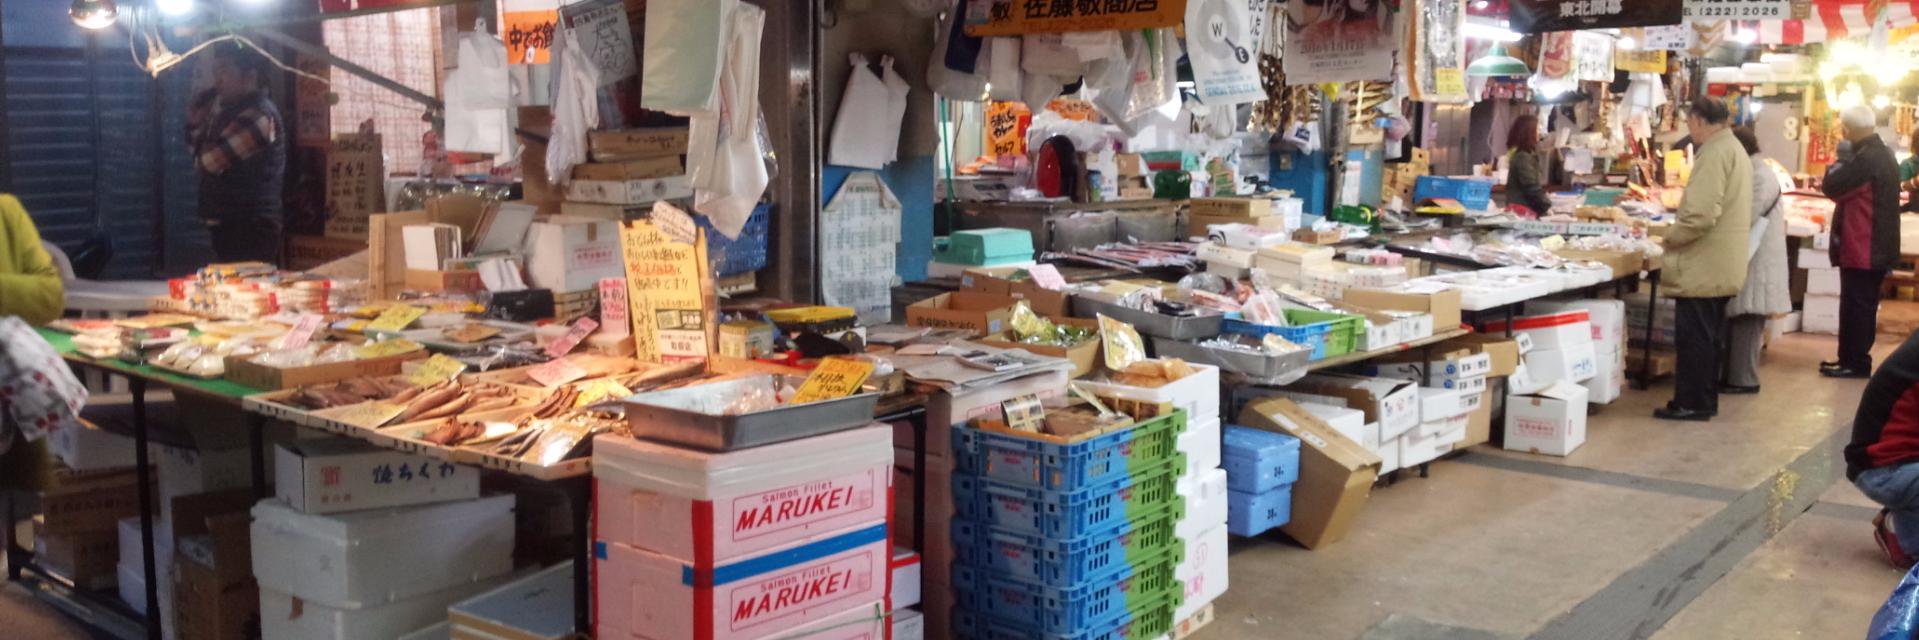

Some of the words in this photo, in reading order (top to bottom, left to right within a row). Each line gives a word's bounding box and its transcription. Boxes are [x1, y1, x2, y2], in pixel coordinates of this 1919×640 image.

[1559, 0, 1622, 17] 東北開幕
[1743, 7, 1779, 16] 2026
[1212, 22, 1223, 37] W
[372, 461, 455, 485] 焼ちくわ
[762, 488, 798, 503] Salmon
[804, 481, 832, 494] Fillet
[735, 485, 854, 533] MARUKEI
[761, 575, 797, 593] Salmon
[802, 566, 831, 580] Fillet
[733, 569, 852, 623] MARUKEI
